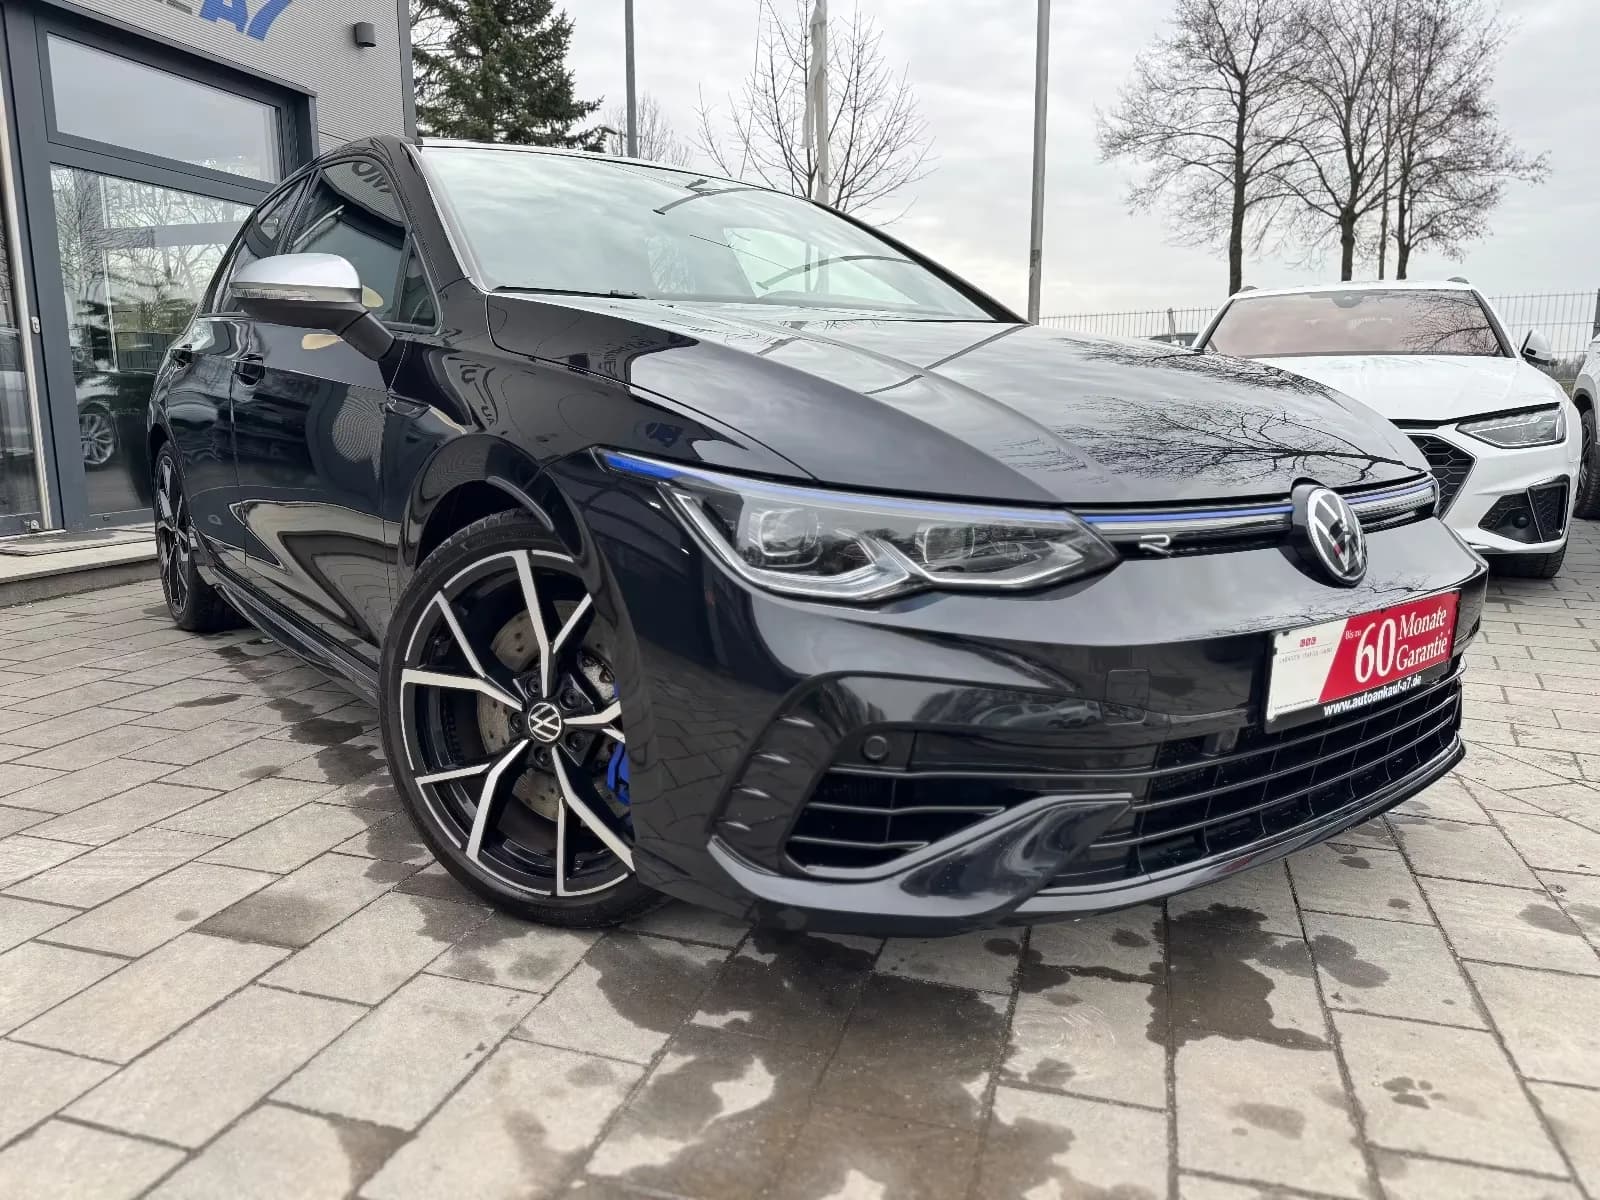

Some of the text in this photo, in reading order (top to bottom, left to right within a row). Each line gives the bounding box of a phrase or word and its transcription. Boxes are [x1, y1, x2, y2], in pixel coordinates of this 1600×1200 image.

[1139, 534, 1174, 554] R
[1398, 605, 1447, 640] Monate
[1355, 618, 1397, 683] 60
[1323, 674, 1422, 716] www.autoankauf-a7.de
